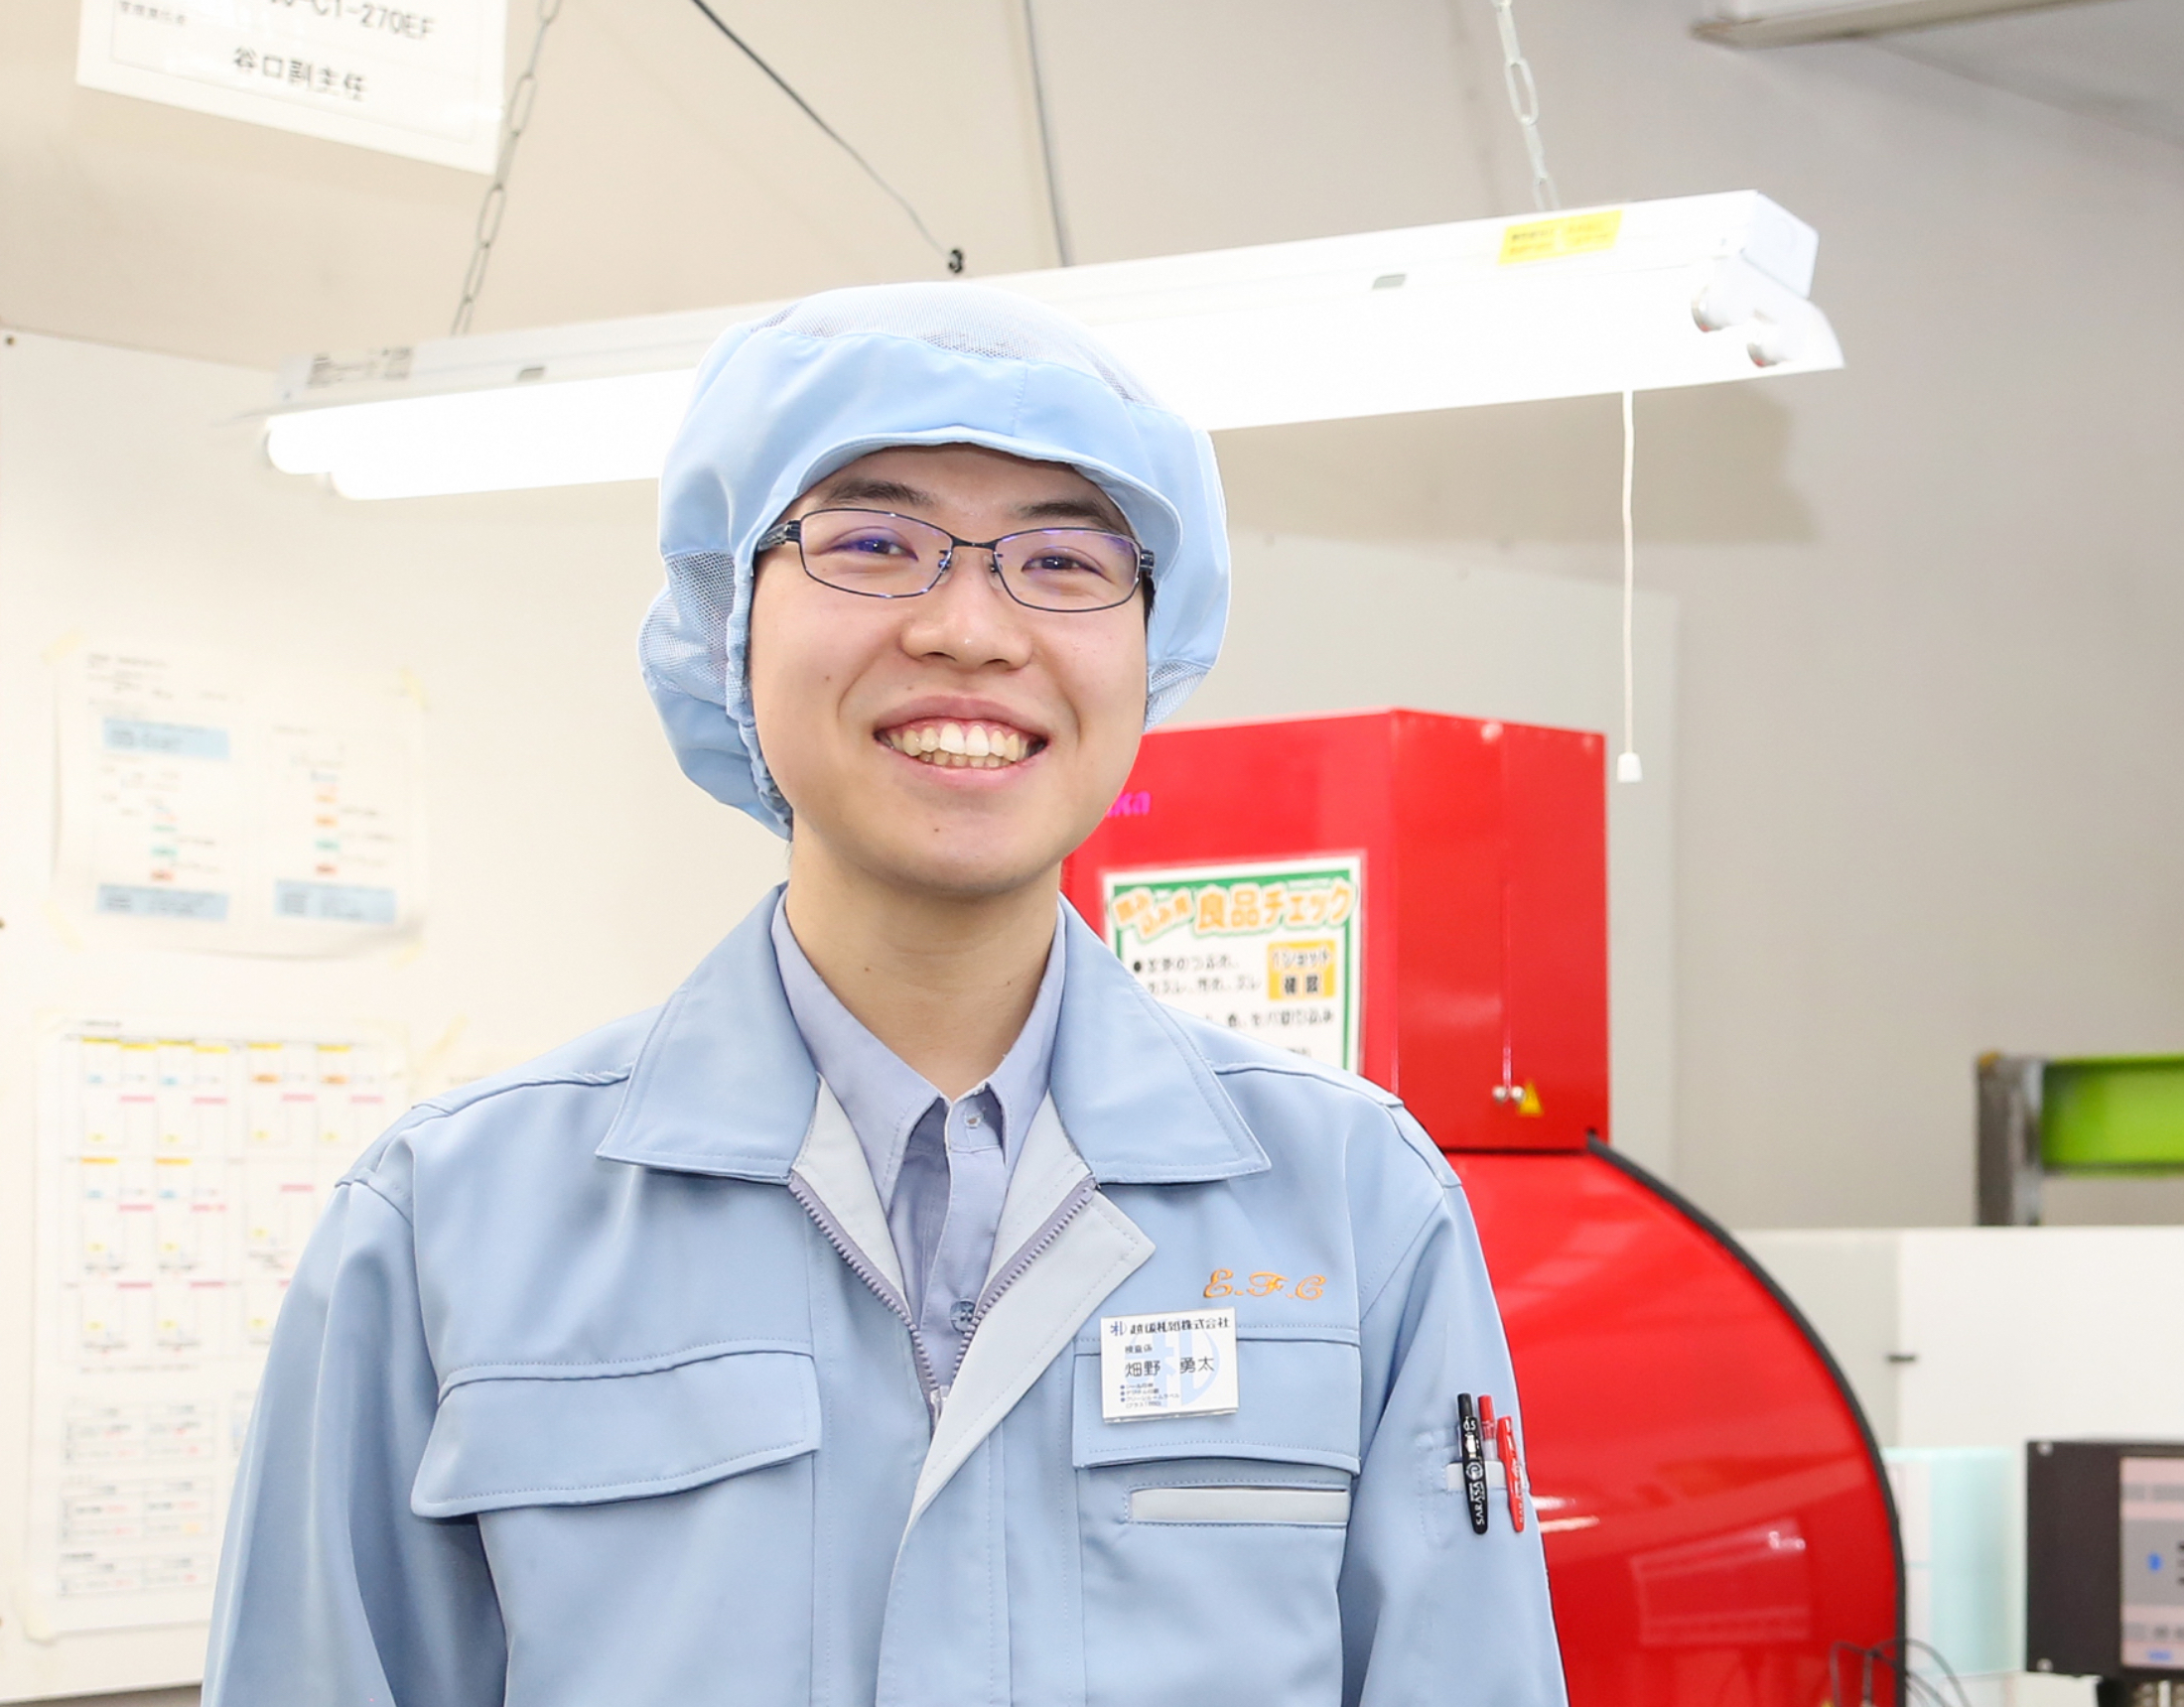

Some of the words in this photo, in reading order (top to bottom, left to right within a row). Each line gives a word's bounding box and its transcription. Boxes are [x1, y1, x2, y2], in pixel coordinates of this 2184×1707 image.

[233, 47, 367, 101] 谷口副主任
[1124, 1360, 1160, 1378] 畑野
[1179, 1356, 1214, 1374] 勇太
